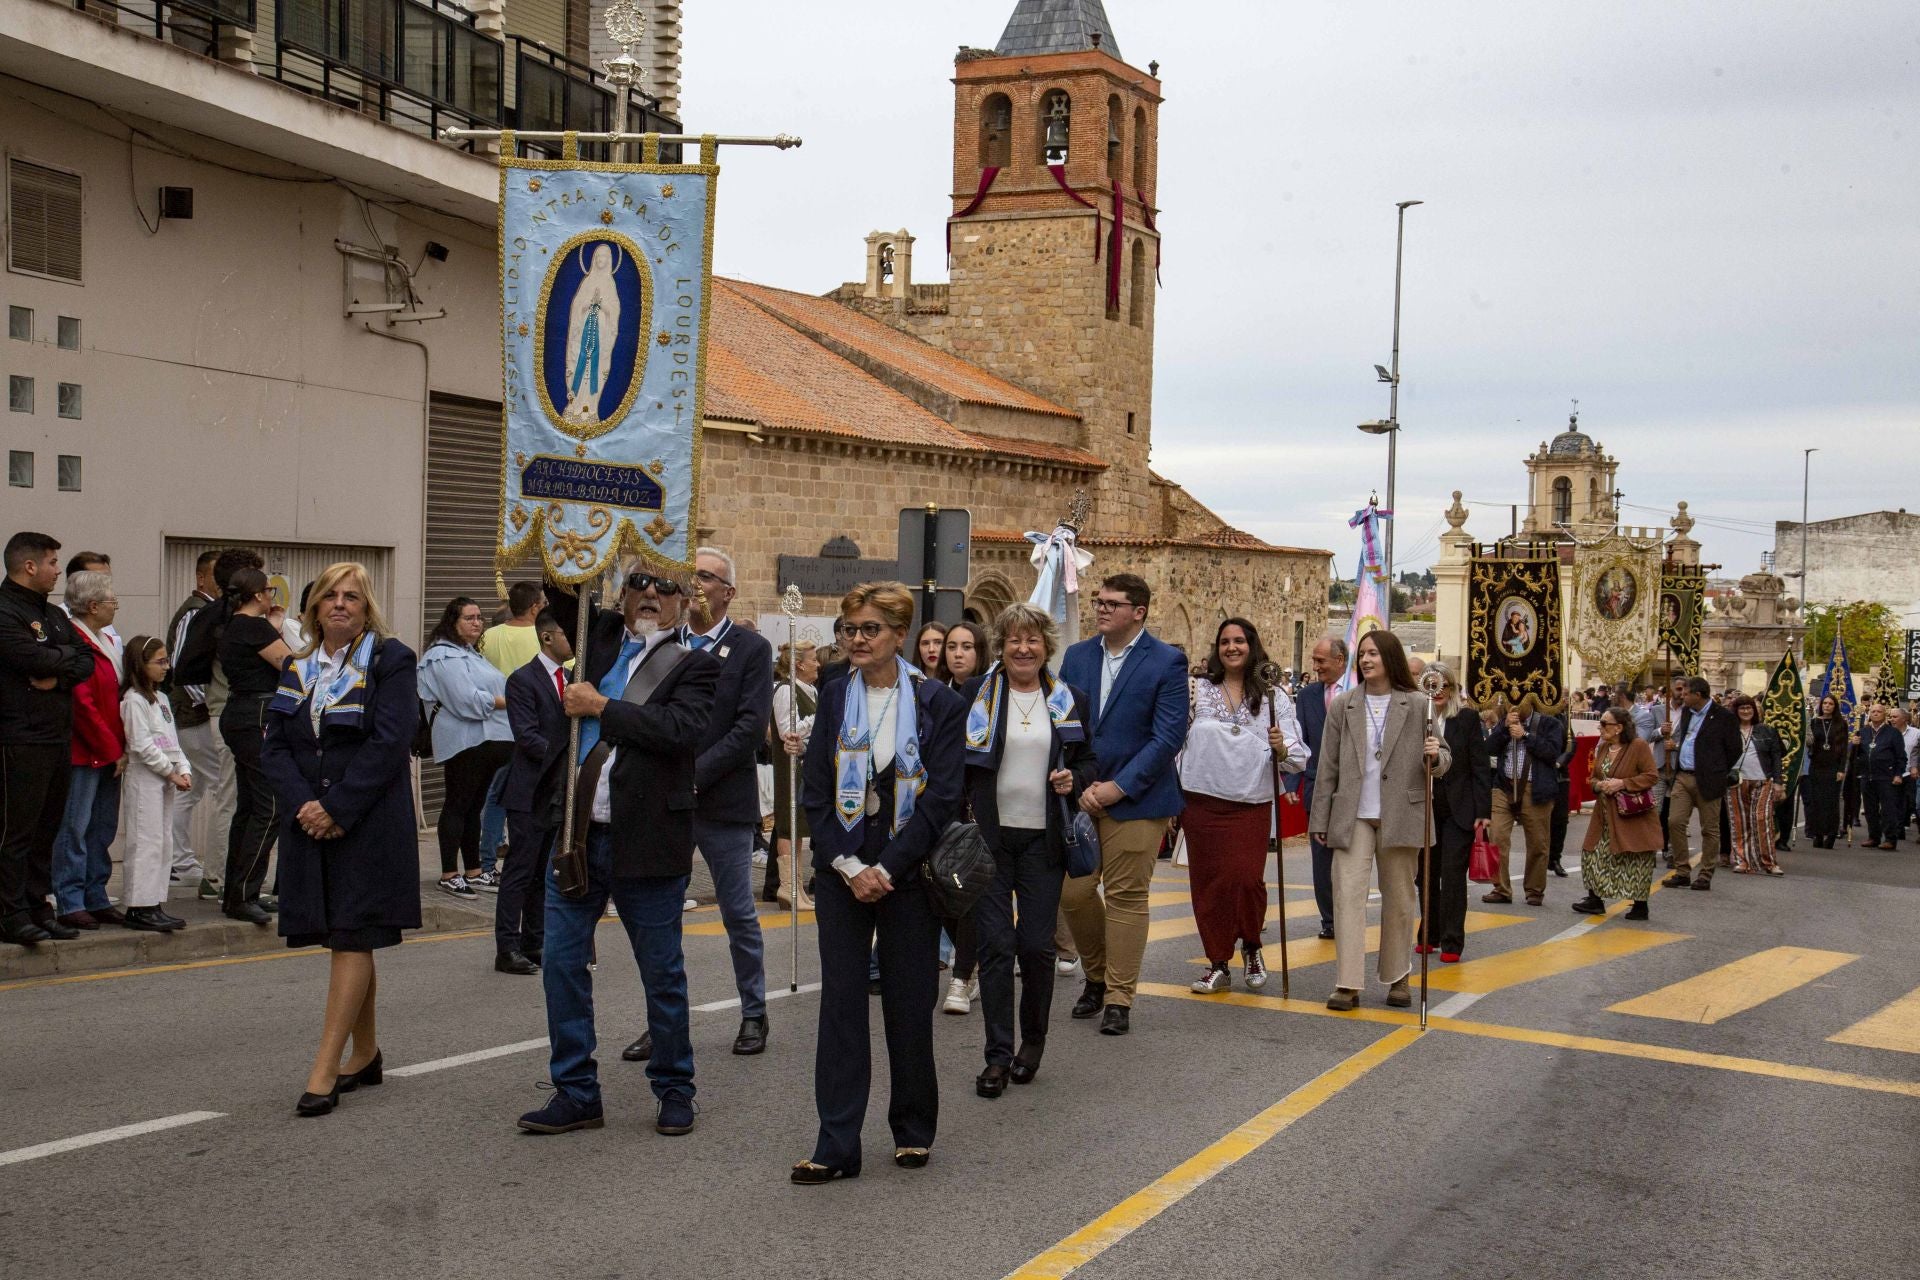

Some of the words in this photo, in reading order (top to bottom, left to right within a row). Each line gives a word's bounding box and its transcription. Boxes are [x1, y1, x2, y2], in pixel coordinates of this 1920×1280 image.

[506, 236, 527, 415] HOSPITALIDAD
[657, 223, 681, 257] DE
[671, 279, 693, 399] LOURDES
[1909, 631, 1920, 691] PARKING
